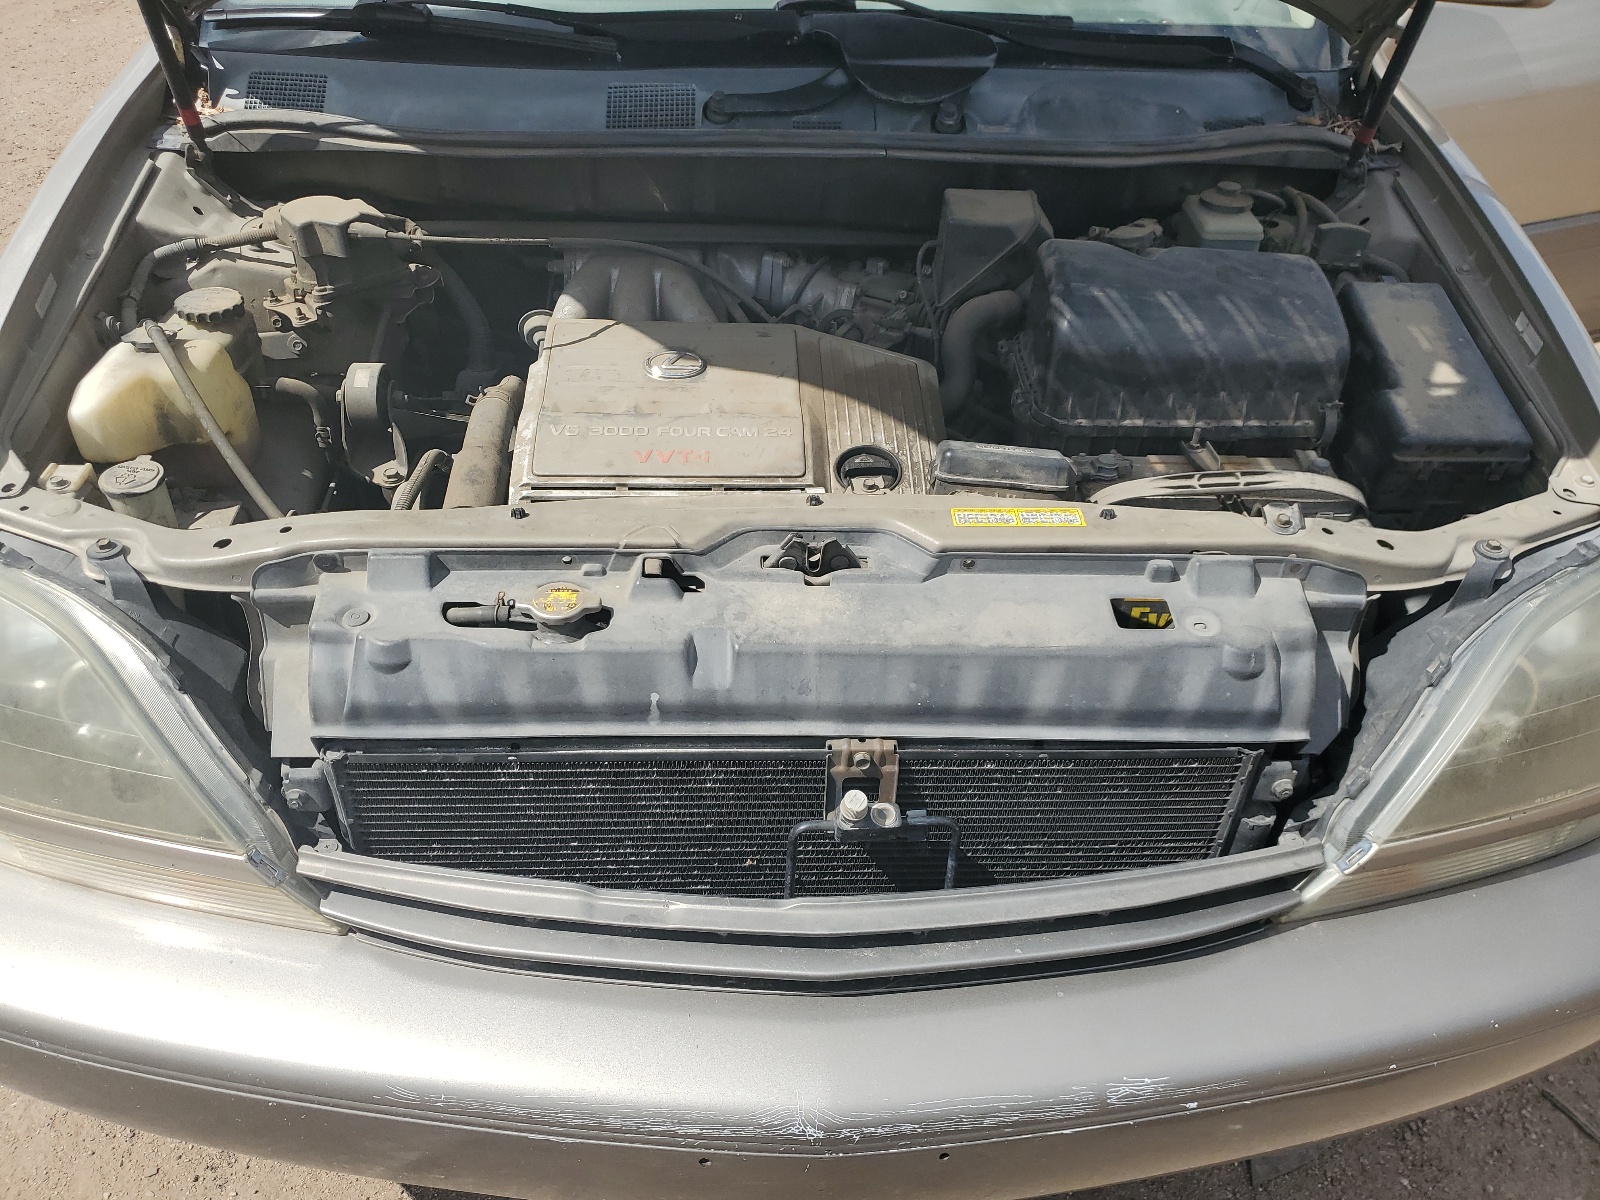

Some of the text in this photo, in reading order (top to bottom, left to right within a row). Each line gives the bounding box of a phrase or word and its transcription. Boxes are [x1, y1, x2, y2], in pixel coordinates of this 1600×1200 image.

[550, 424, 794, 438] V6 3000 FOUR CAM 24
